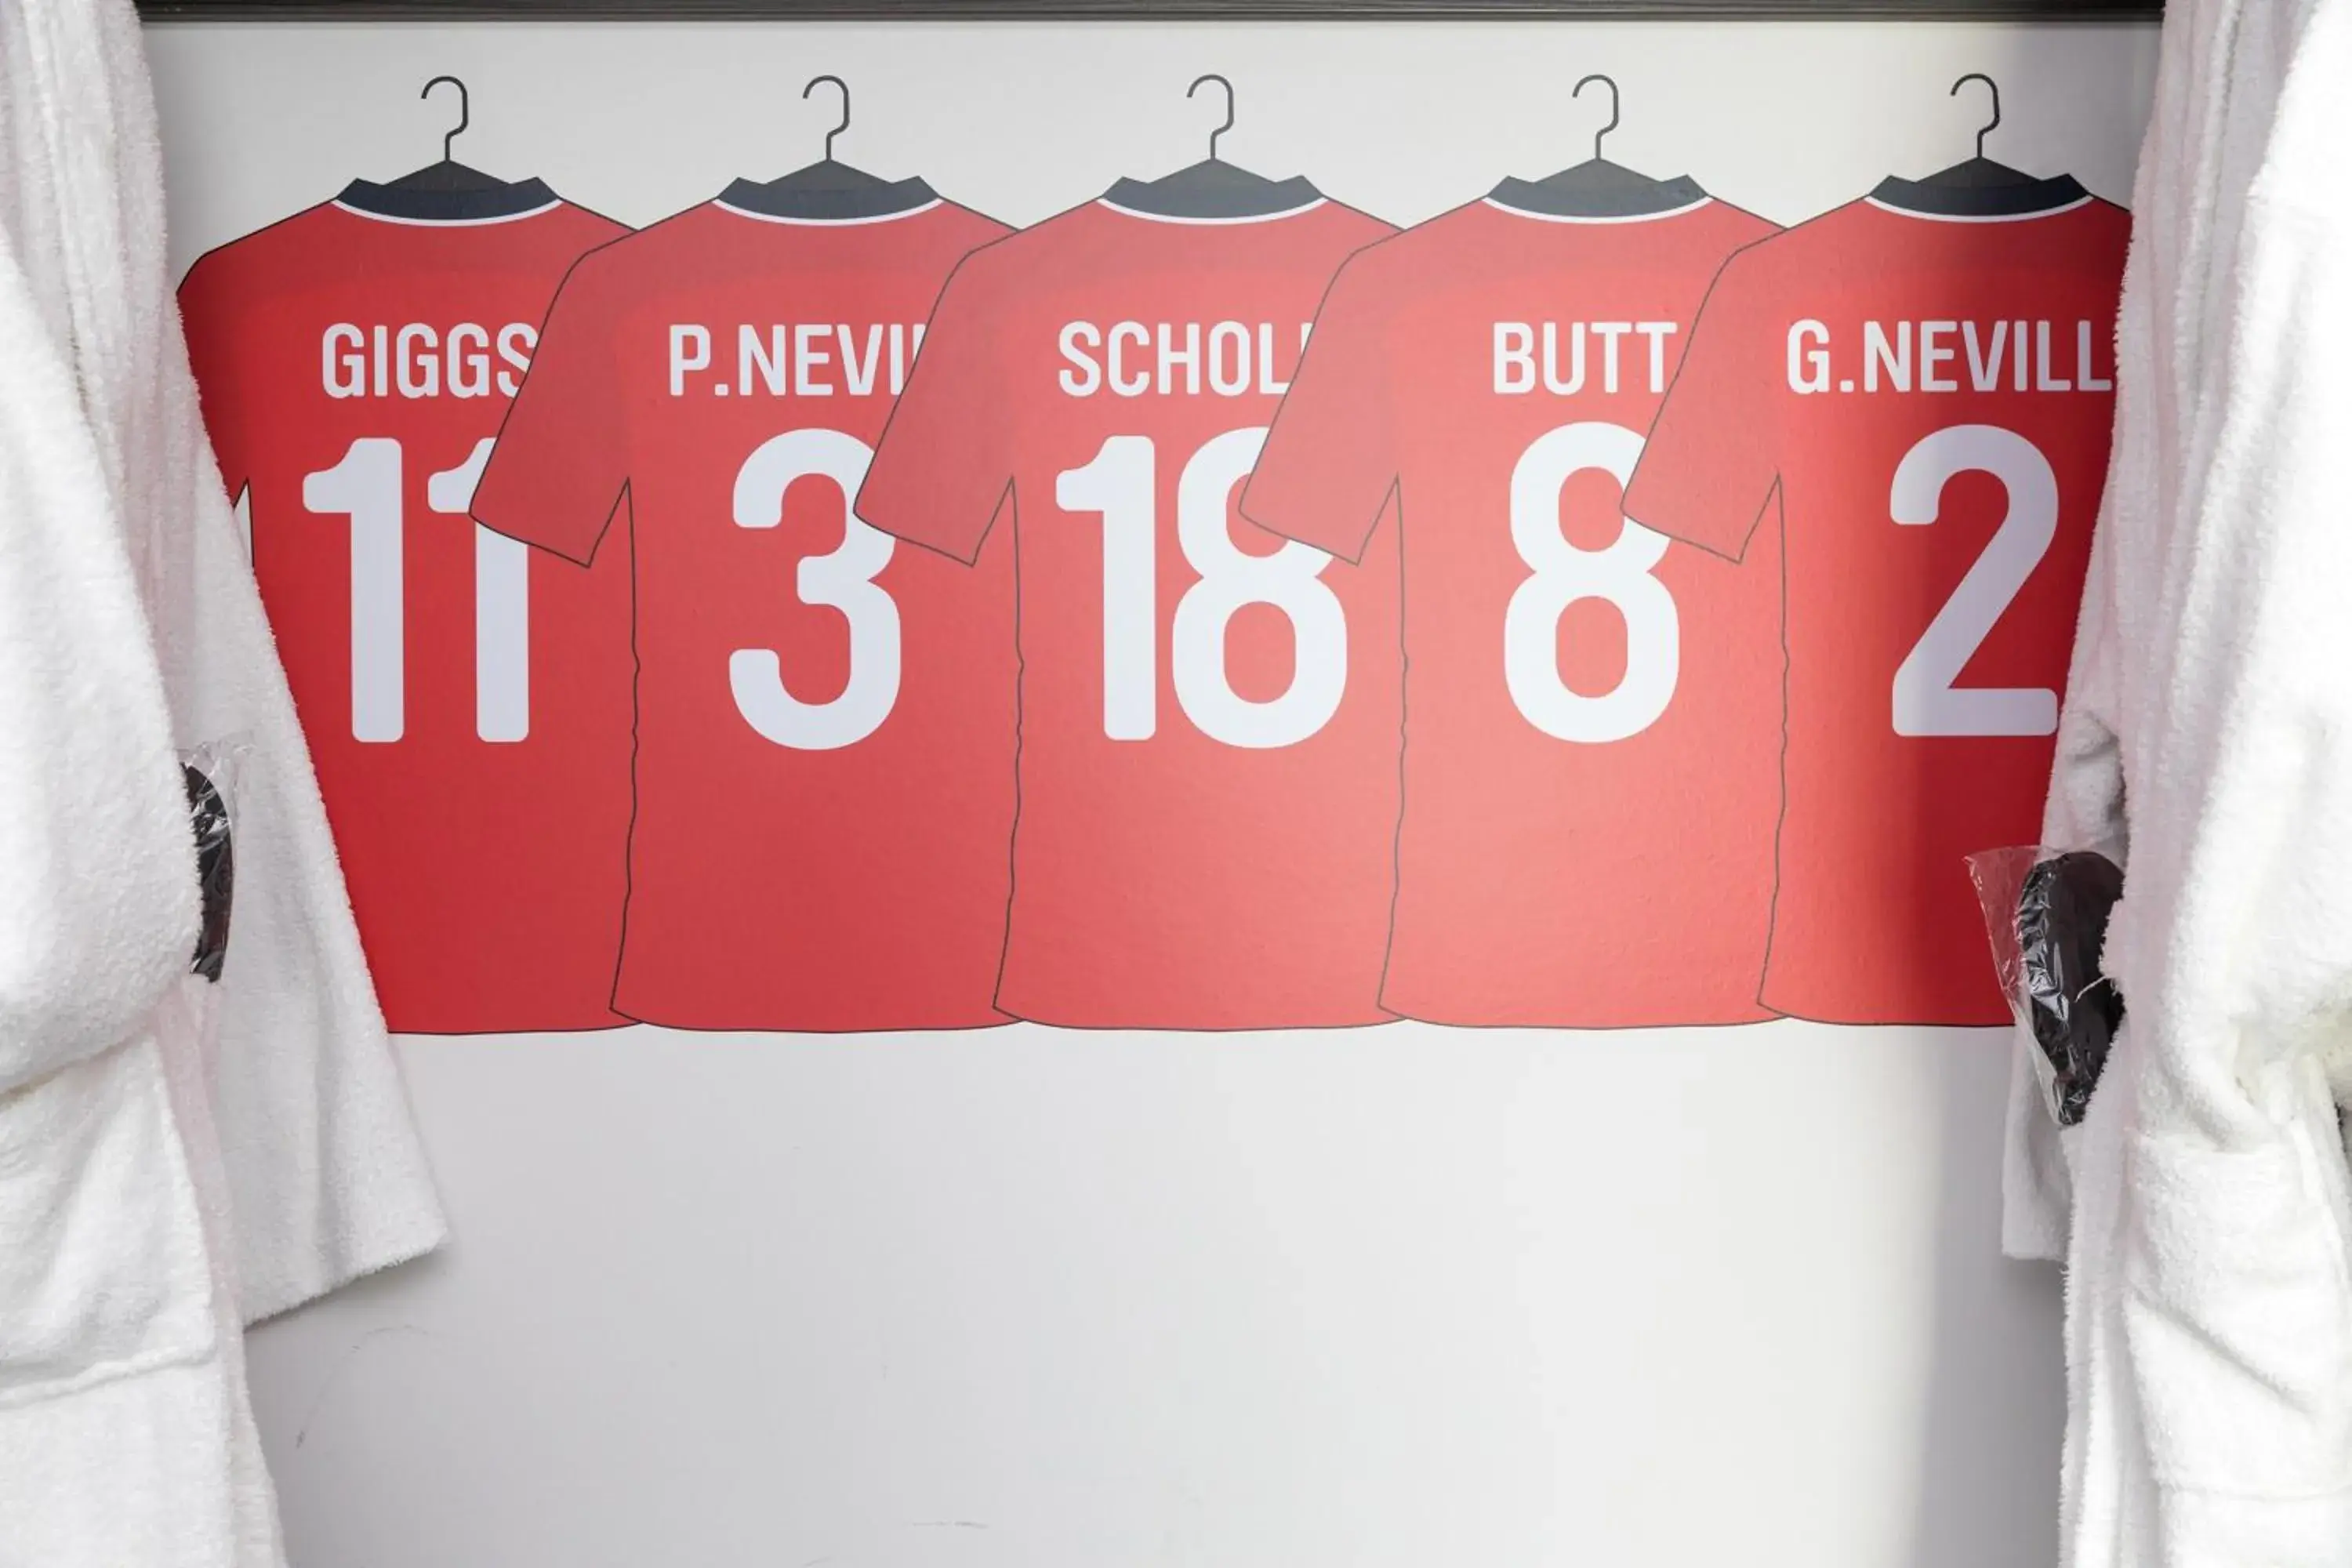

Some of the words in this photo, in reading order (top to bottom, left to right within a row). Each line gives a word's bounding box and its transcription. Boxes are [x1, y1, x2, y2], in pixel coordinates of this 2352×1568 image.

[322, 322, 539, 398] GIGGS
[1058, 320, 1314, 397] SCHOL
[1492, 321, 1679, 395] BUTT
[1787, 319, 2112, 394] G.NEVILL
[303, 437, 529, 742] 11
[730, 429, 902, 750] 3
[1055, 426, 1348, 749] 18
[1504, 421, 1679, 743] 8
[1890, 424, 2059, 737] 2
